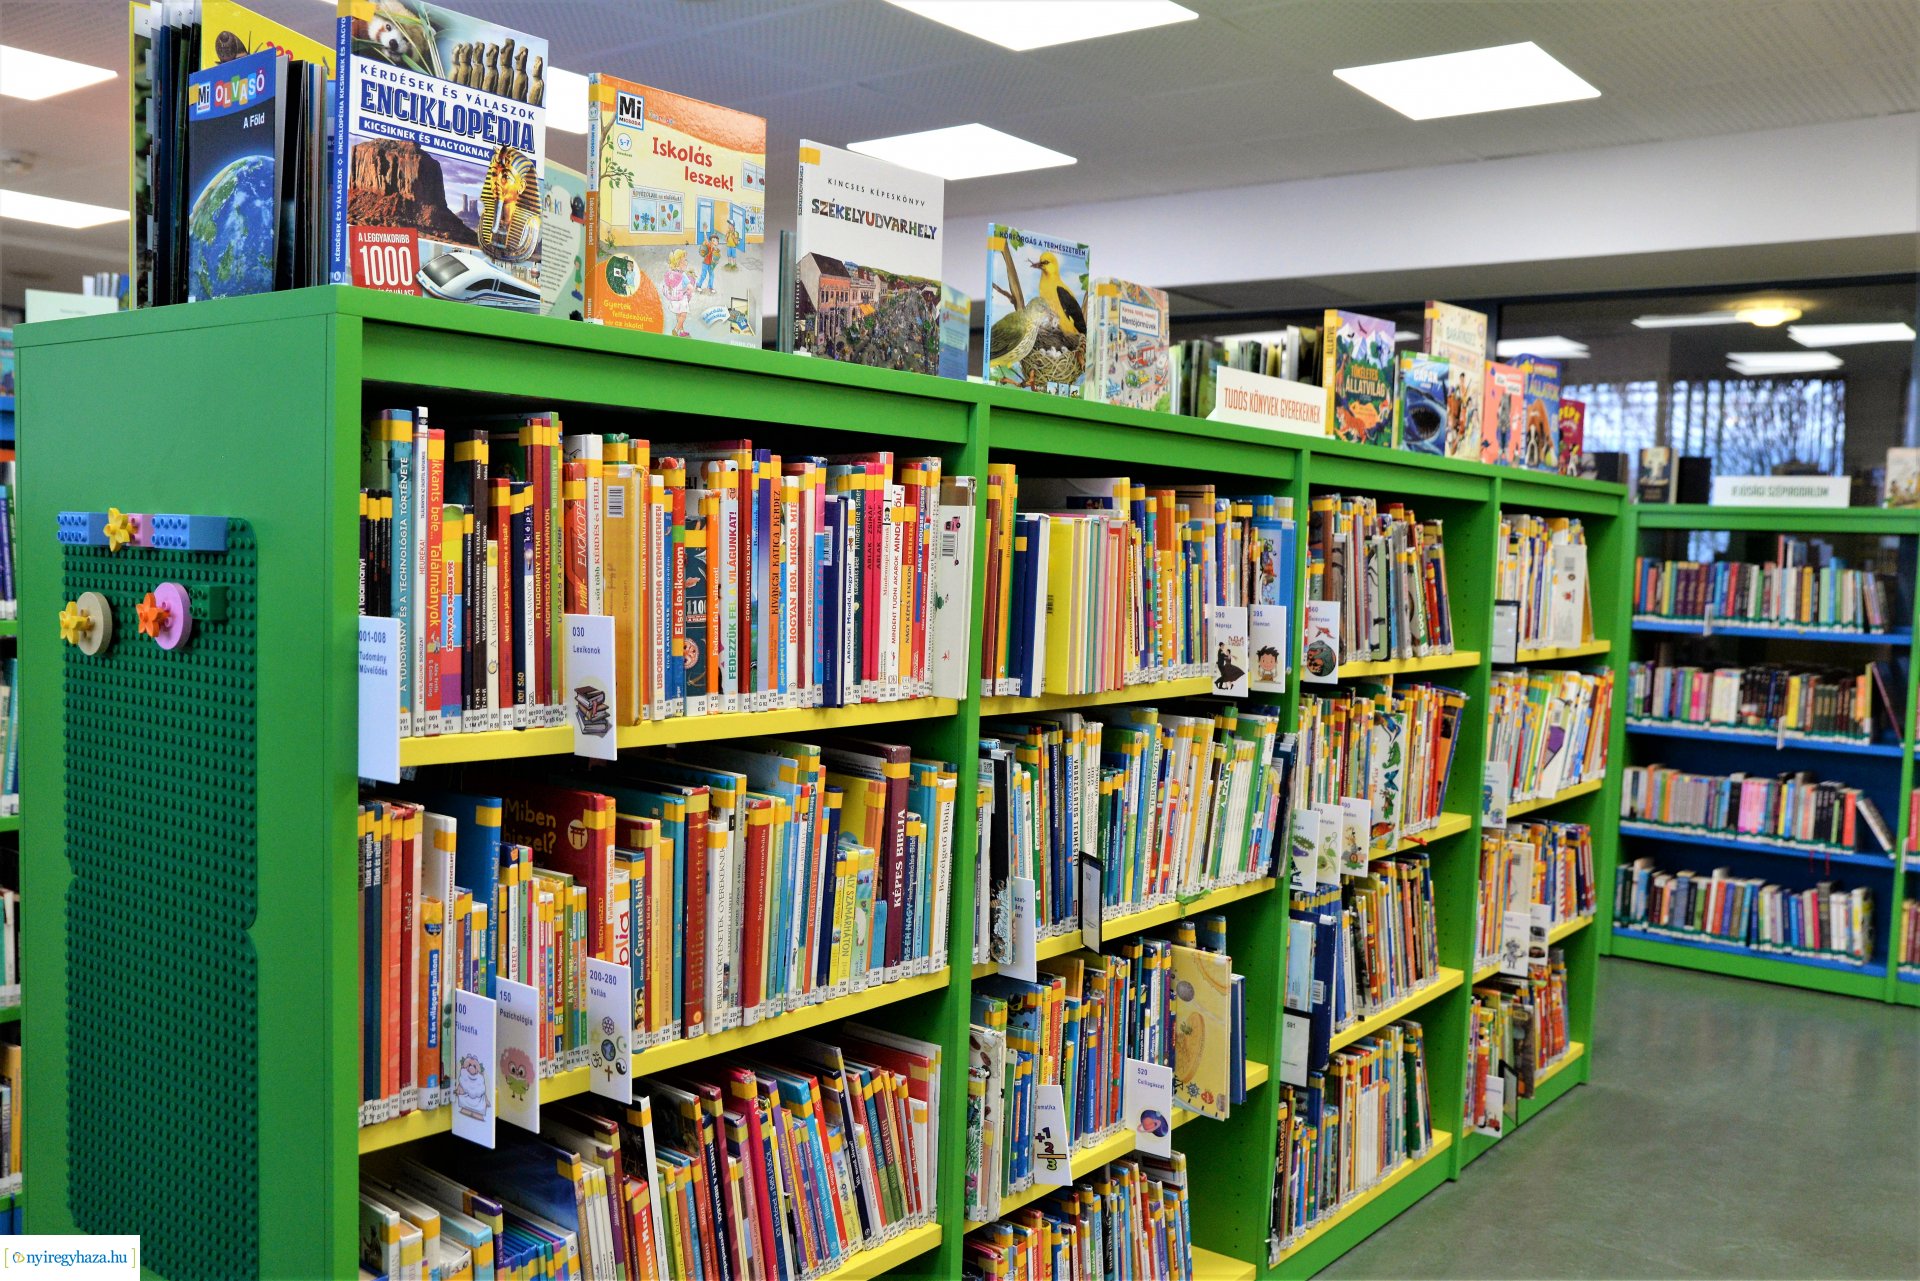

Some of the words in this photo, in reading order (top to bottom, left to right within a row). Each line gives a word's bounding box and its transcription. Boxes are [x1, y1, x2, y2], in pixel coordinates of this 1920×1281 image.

[215, 69, 265, 104] OLVASÓ
[361, 64, 434, 93] KÉRDÉSEK
[442, 86, 458, 99] ÉS
[466, 93, 534, 120] VÁLASZOK
[243, 117, 248, 129] A
[250, 113, 264, 126] Föld
[361, 79, 535, 154] ENCIKLOPÉDIA
[619, 96, 642, 120] Mi
[364, 120, 415, 141] KICSIKNEK
[419, 133, 430, 144] ÉS
[434, 137, 490, 158] NAGYOKNAK
[653, 136, 712, 167] Iskolás
[685, 166, 733, 192] leszek!
[828, 178, 864, 192] KINCSES
[870, 188, 925, 207] KÉPESKÖNYV
[336, 211, 342, 221] ÉS
[812, 198, 937, 239] SZÉKELYUDVARHELY
[358, 233, 363, 242] A
[365, 232, 410, 244] LEGGYAKORIBB
[1000, 231, 1036, 246] KÖRFORGÁS
[1044, 240, 1086, 256] TERMÉSZETBEN
[359, 246, 413, 286] 1000
[1225, 386, 1247, 410] TUDÓS
[1250, 390, 1278, 416] KÖNYVEK
[1280, 398, 1320, 424] GYEREKEKNEK
[399, 457, 409, 515] TÖRTÉNETE
[771, 490, 781, 527] KÉRDEZ
[399, 519, 407, 593] TECHNOLÓGIA
[726, 511, 736, 584] VILÁGUNKAT!
[771, 532, 780, 567] KATICA
[789, 528, 797, 565] MIKOR
[426, 544, 441, 626] Találmányok
[446, 576, 454, 606] KÉRDÉS
[673, 547, 684, 607] lexikonom
[789, 570, 797, 592] HOL
[770, 573, 779, 615] KÍVÁNCSI
[398, 606, 407, 618] ÉS
[489, 584, 498, 636] tudomány
[654, 580, 663, 645] ENCIKLOPÉDIA
[674, 610, 684, 635] Első
[728, 601, 736, 620] FEL
[359, 630, 386, 643] 001-008
[446, 617, 454, 651] VÁLASZ
[490, 639, 497, 648] A
[572, 626, 584, 637] 030
[359, 651, 387, 664] Tudomány
[399, 621, 407, 682] TUDOMÁNY
[573, 645, 600, 655] Lexikonok
[727, 624, 736, 680] FEDEZZÜK
[359, 663, 388, 676] Művelődés
[401, 684, 406, 692] A
[505, 798, 556, 828] Miben
[942, 801, 951, 833] Biblia
[365, 833, 374, 860] rejtélyek
[896, 809, 906, 857] BIBLIA
[365, 869, 373, 887] Titkok
[373, 868, 381, 886] Titkok
[938, 836, 948, 892] Beszélgető
[892, 861, 903, 907] KÉPES
[841, 890, 854, 956] SZAMÁRHÁTON
[715, 915, 724, 976] TÖRTÉNETEK
[429, 953, 438, 987] lexikona
[590, 970, 617, 986] 200-280
[429, 989, 438, 1019] világom
[500, 990, 511, 1002] 150
[715, 980, 723, 1009] BIBLIAI
[430, 1021, 437, 1031] én
[430, 1033, 437, 1044] Az
